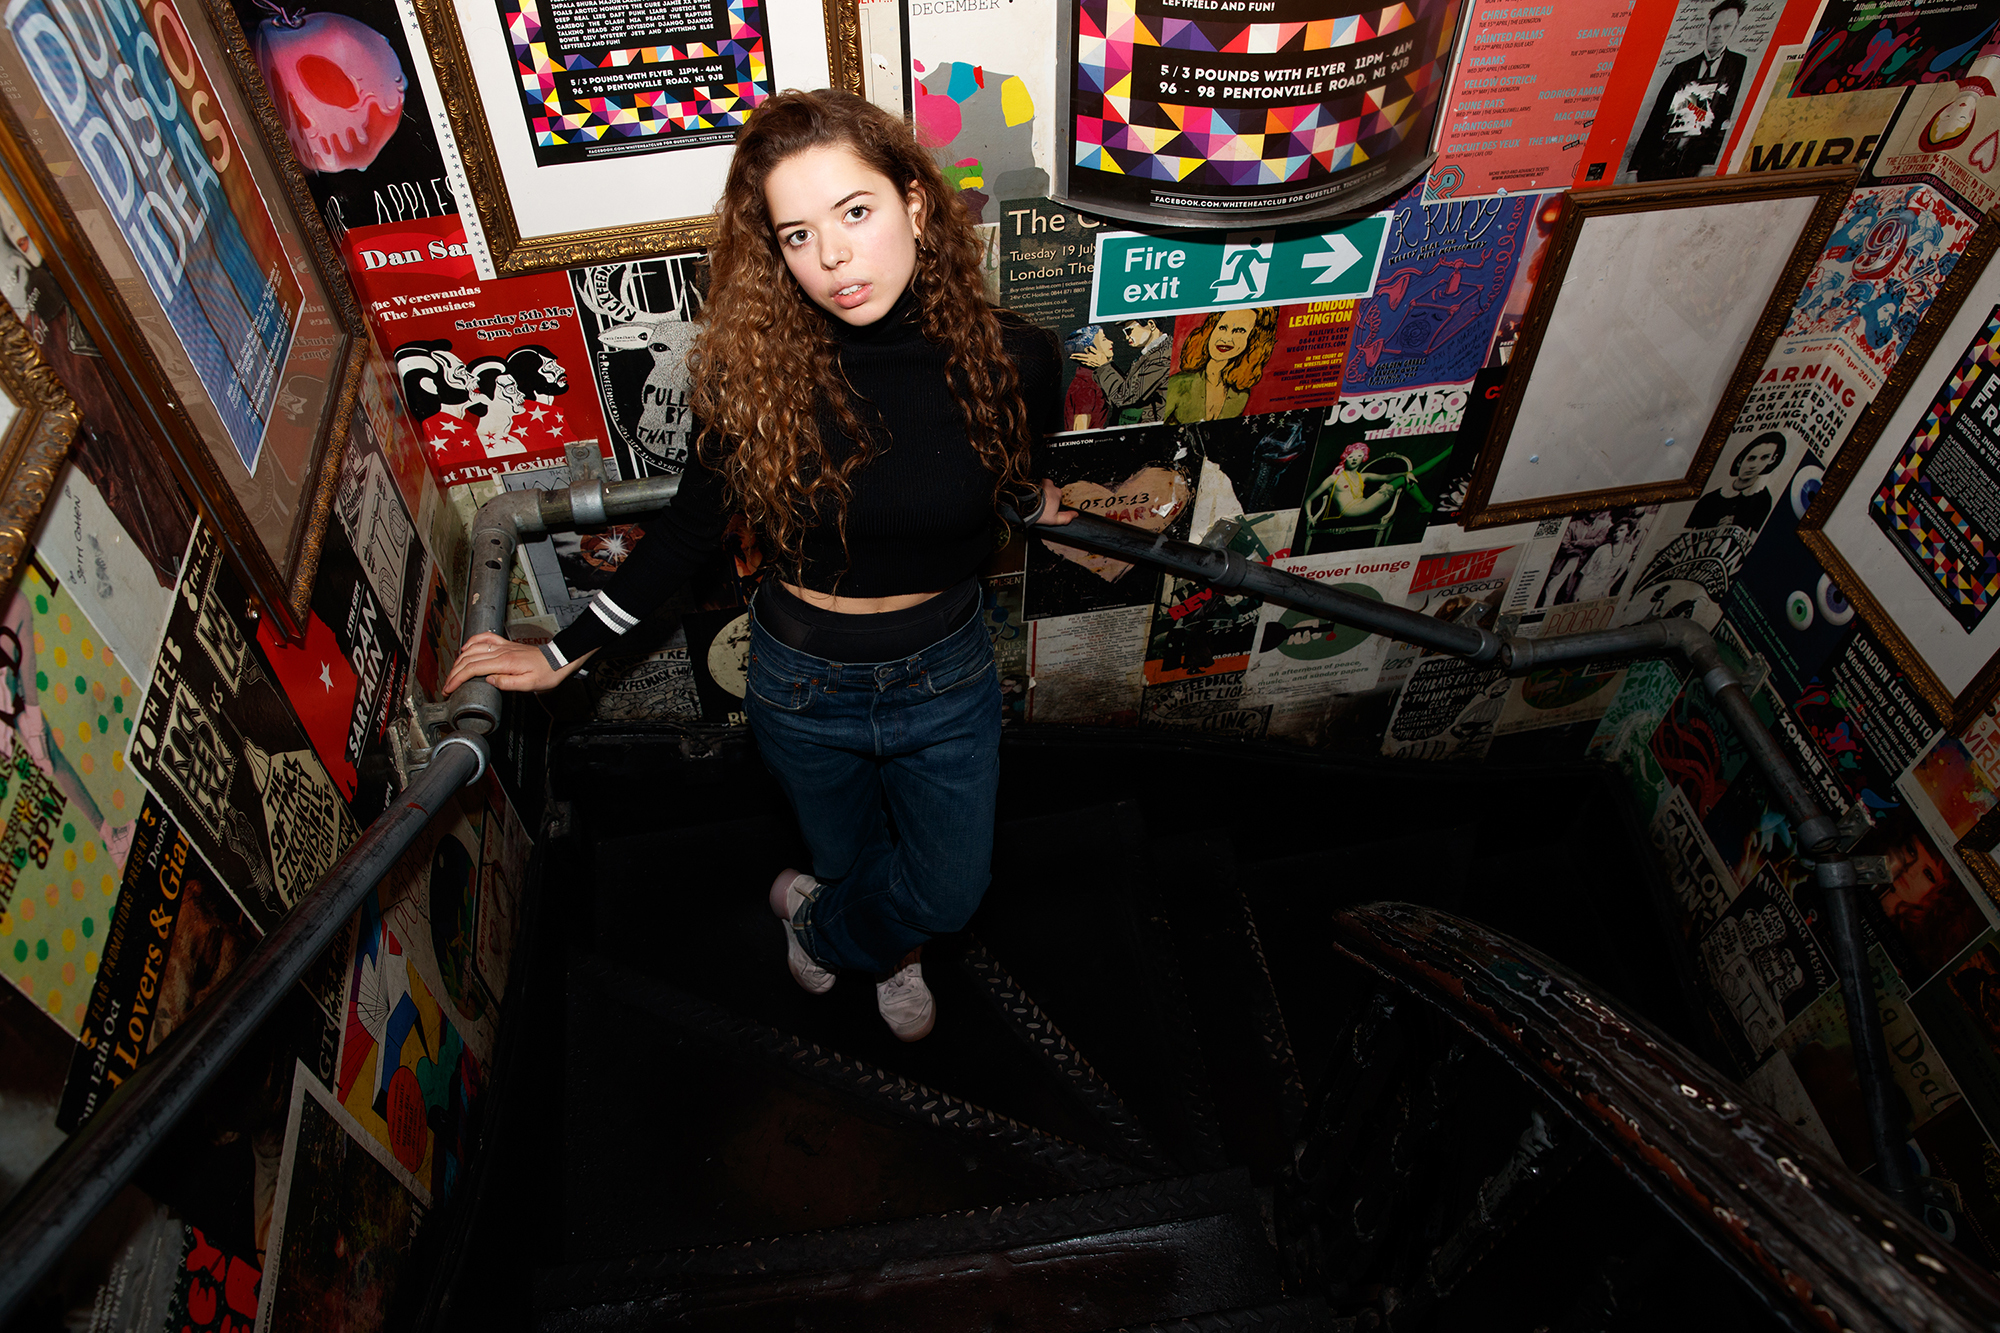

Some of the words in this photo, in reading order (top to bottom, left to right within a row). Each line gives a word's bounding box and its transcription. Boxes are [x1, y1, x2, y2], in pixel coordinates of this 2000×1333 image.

[671, 5, 696, 13] JUSTICE
[912, 0, 1001, 16] DECEMBER
[1163, 0, 1218, 10] LEFTFIELD
[1221, 1, 1245, 11] AND
[1248, 2, 1275, 12] FUN!
[1481, 8, 1509, 21] CHRIS
[1510, 6, 1554, 18] GARNEAU
[1852, 1, 1876, 12] Album
[556, 22, 584, 30] CARIBOU
[646, 14, 665, 22] PEACE
[685, 10, 712, 18] RAPTURE
[557, 29, 584, 37] TALKING
[627, 22, 655, 30] DIVISION
[687, 17, 713, 25] DJANGO
[600, 32, 627, 40] MYSTERY
[665, 25, 697, 34] ANYTHING
[1475, 32, 1513, 45] PAINTED
[1514, 29, 1544, 42] PALMS
[1576, 28, 1601, 40] SEAN
[560, 42, 590, 50] LEFTFIELD
[1161, 65, 1169, 76] 5
[1182, 67, 1190, 78] 3
[1195, 68, 1259, 82] POUNDS
[1264, 68, 1302, 82] WITH
[1306, 62, 1346, 78] FLYER
[1355, 52, 1384, 69] 11PM
[1392, 40, 1413, 57] 4AM
[1469, 55, 1506, 67] TRAAMS
[572, 87, 583, 95] 96
[593, 85, 603, 93] 98
[607, 80, 662, 92] PENTONVILLE
[708, 73, 724, 81] 9JB
[582, 77, 587, 85] 3
[589, 74, 624, 84] POUNDS
[625, 72, 648, 81] WITH
[649, 70, 673, 80] FLYER
[679, 66, 698, 75] 11PM
[705, 64, 722, 73] 4AM
[1159, 82, 1177, 95] 96
[1198, 86, 1215, 98] 98
[1223, 82, 1322, 99] PENTONVILLE
[1329, 75, 1367, 91] ROAD,
[1373, 67, 1386, 79] N1
[1391, 56, 1410, 73] 9JB
[1464, 77, 1498, 89] YELLOW
[1499, 75, 1537, 86] OSTRICH
[1538, 88, 1577, 100] RODRIGO
[1458, 100, 1482, 111] DUNE
[1484, 98, 1505, 109] RATS
[1554, 110, 1573, 121] MAC
[1452, 119, 1513, 133] PHANTOGRAM
[1447, 141, 1480, 153] CIRCUIT
[1481, 140, 1497, 150] DES
[1498, 139, 1521, 149] YEUX
[1528, 136, 1544, 146] THE
[1546, 134, 1565, 145] WAR
[1155, 196, 1287, 208] FACEBOOK.COM/WHITEHEATCLUB
[1289, 195, 1303, 204] FOR
[1008, 208, 1066, 236] The
[359, 249, 424, 270] Dan
[1010, 247, 1057, 262] Tuesday
[1063, 245, 1075, 257] 19
[1125, 247, 1186, 272] Fire
[1010, 266, 1063, 282] London
[392, 285, 481, 307] Werewandas
[1124, 276, 1180, 303] exit
[380, 309, 409, 323] The
[411, 299, 476, 317] Amusiacs
[1308, 299, 1355, 313] LONDON
[455, 313, 516, 331] Saturday
[519, 310, 542, 322] 5th
[544, 306, 574, 321] May
[1289, 310, 1353, 328] LEXINGTON
[477, 326, 512, 342] 8pm,
[513, 323, 538, 336] adv
[539, 319, 559, 333] £8
[1844, 355, 1859, 372] Apr
[1858, 369, 1876, 390] 2012
[644, 384, 689, 407] PULL
[665, 406, 688, 425] BY
[1791, 389, 1826, 408] KEEP
[1826, 410, 1843, 429] AN
[1756, 402, 1775, 412] ON
[1781, 400, 1804, 409] ALL
[1810, 405, 1837, 441] YOUR
[638, 427, 675, 445] THAT
[1058, 438, 1094, 447] LEXINGTON
[1759, 421, 1780, 431] PIN
[1783, 420, 1824, 459] NUMBERS
[1809, 424, 1831, 448] AND
[460, 464, 498, 481] The
[1080, 492, 1150, 511] 05.05.13
[1286, 564, 1308, 573] the
[1355, 560, 1410, 574] lounge
[352, 590, 378, 679] DAN
[153, 636, 184, 698] FEB
[1852, 632, 1891, 683] LONDON
[1280, 665, 1324, 677] afternoon
[1306, 670, 1338, 681] sunday
[1339, 667, 1369, 678] papers
[1840, 662, 1852, 678] Buy
[1850, 677, 1866, 700] online
[1845, 646, 1889, 708] Wednesday
[1887, 706, 1896, 716] 6
[348, 633, 385, 759] SARTAIN
[1779, 712, 1823, 776] ZOMBIE
[266, 766, 283, 812] THE
[28, 782, 68, 870] 8PM
[147, 816, 170, 872] Doors
[91, 979, 110, 1022] FLAG
[104, 891, 134, 979] PROMOTIONS
[126, 830, 150, 891] PRESENT
[114, 940, 164, 1071] Lovers
[148, 903, 173, 941] &
[103, 997, 122, 1038] Oct
[1889, 1027, 1963, 1114] Deal
